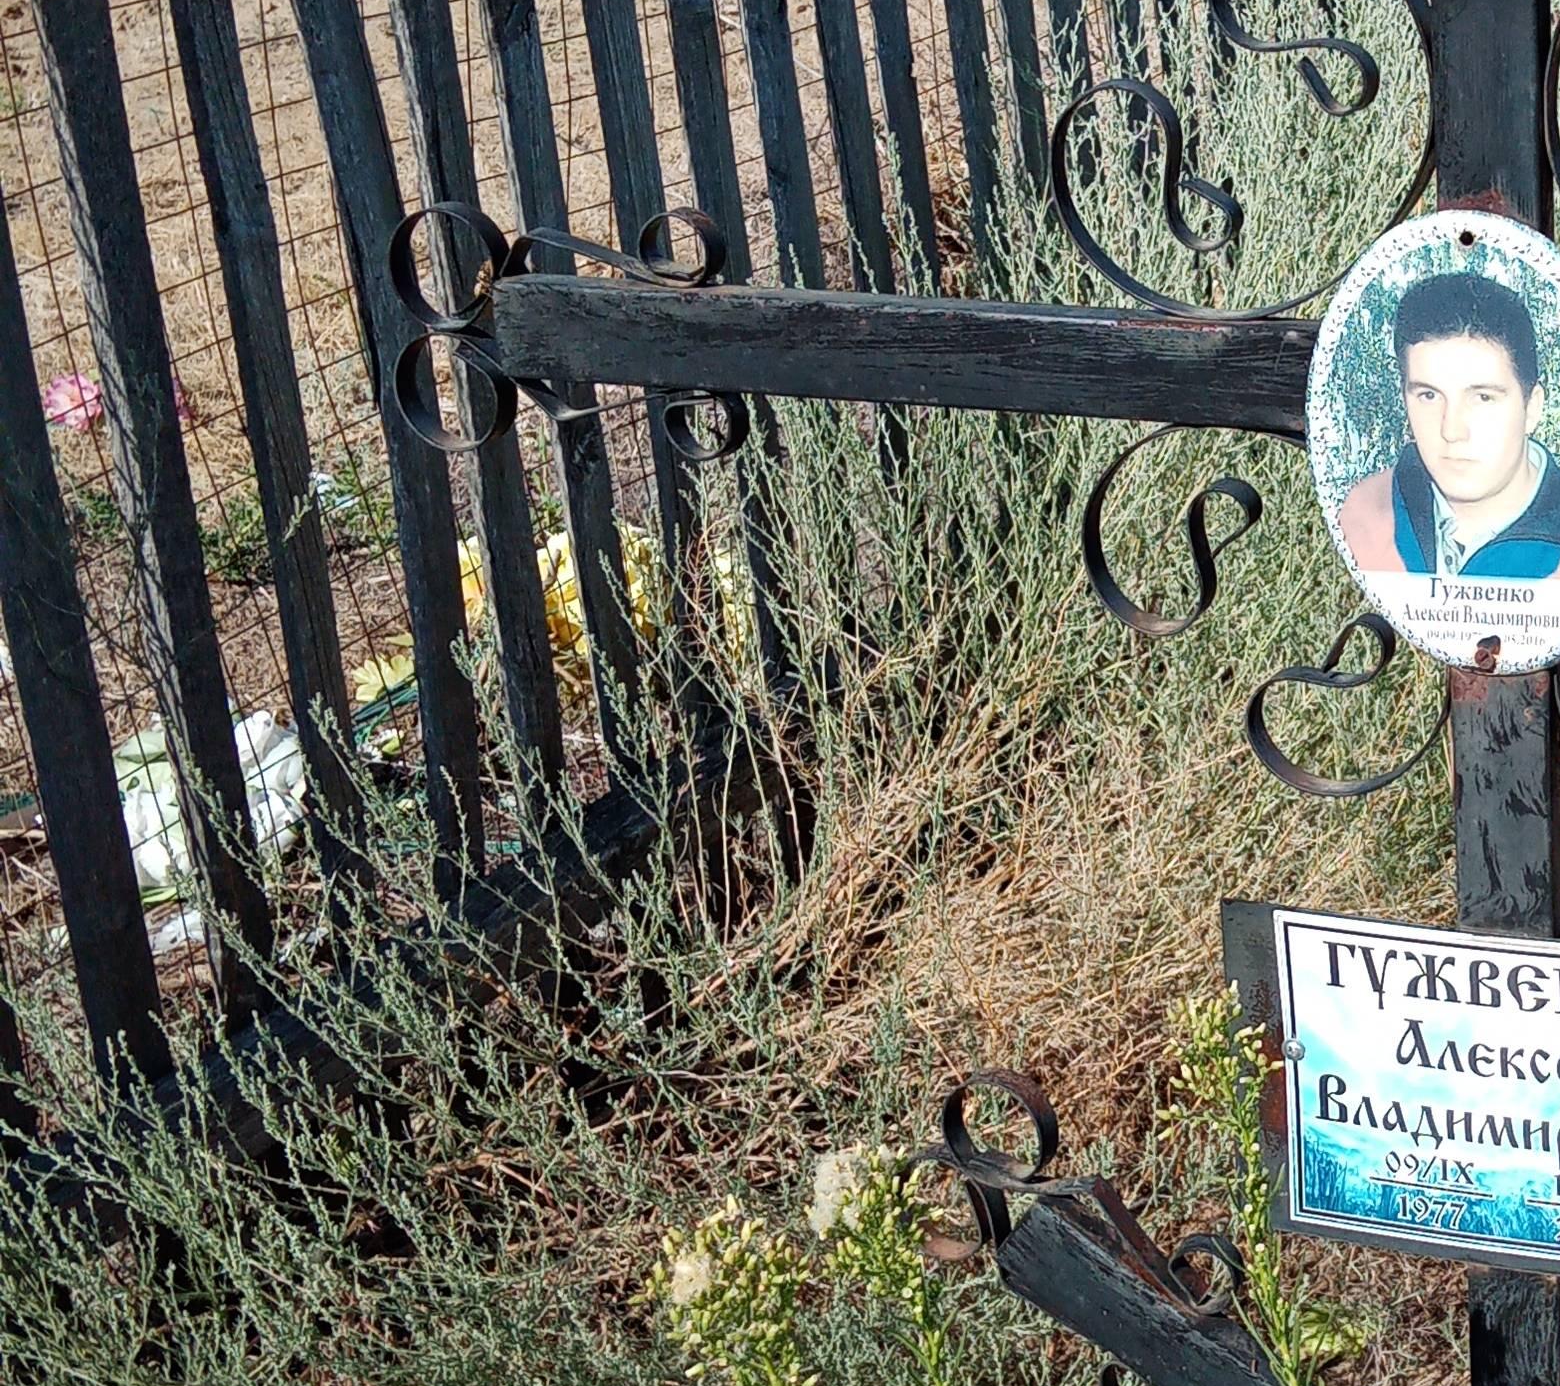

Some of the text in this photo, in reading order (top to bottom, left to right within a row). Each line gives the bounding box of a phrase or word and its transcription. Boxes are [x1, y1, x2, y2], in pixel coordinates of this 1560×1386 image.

[1430, 577, 1535, 605] Гужвенко
[1403, 603, 1459, 623] Алексей
[1385, 1150, 1475, 1185] 09/IX
[1400, 1195, 1466, 1228] 1977
